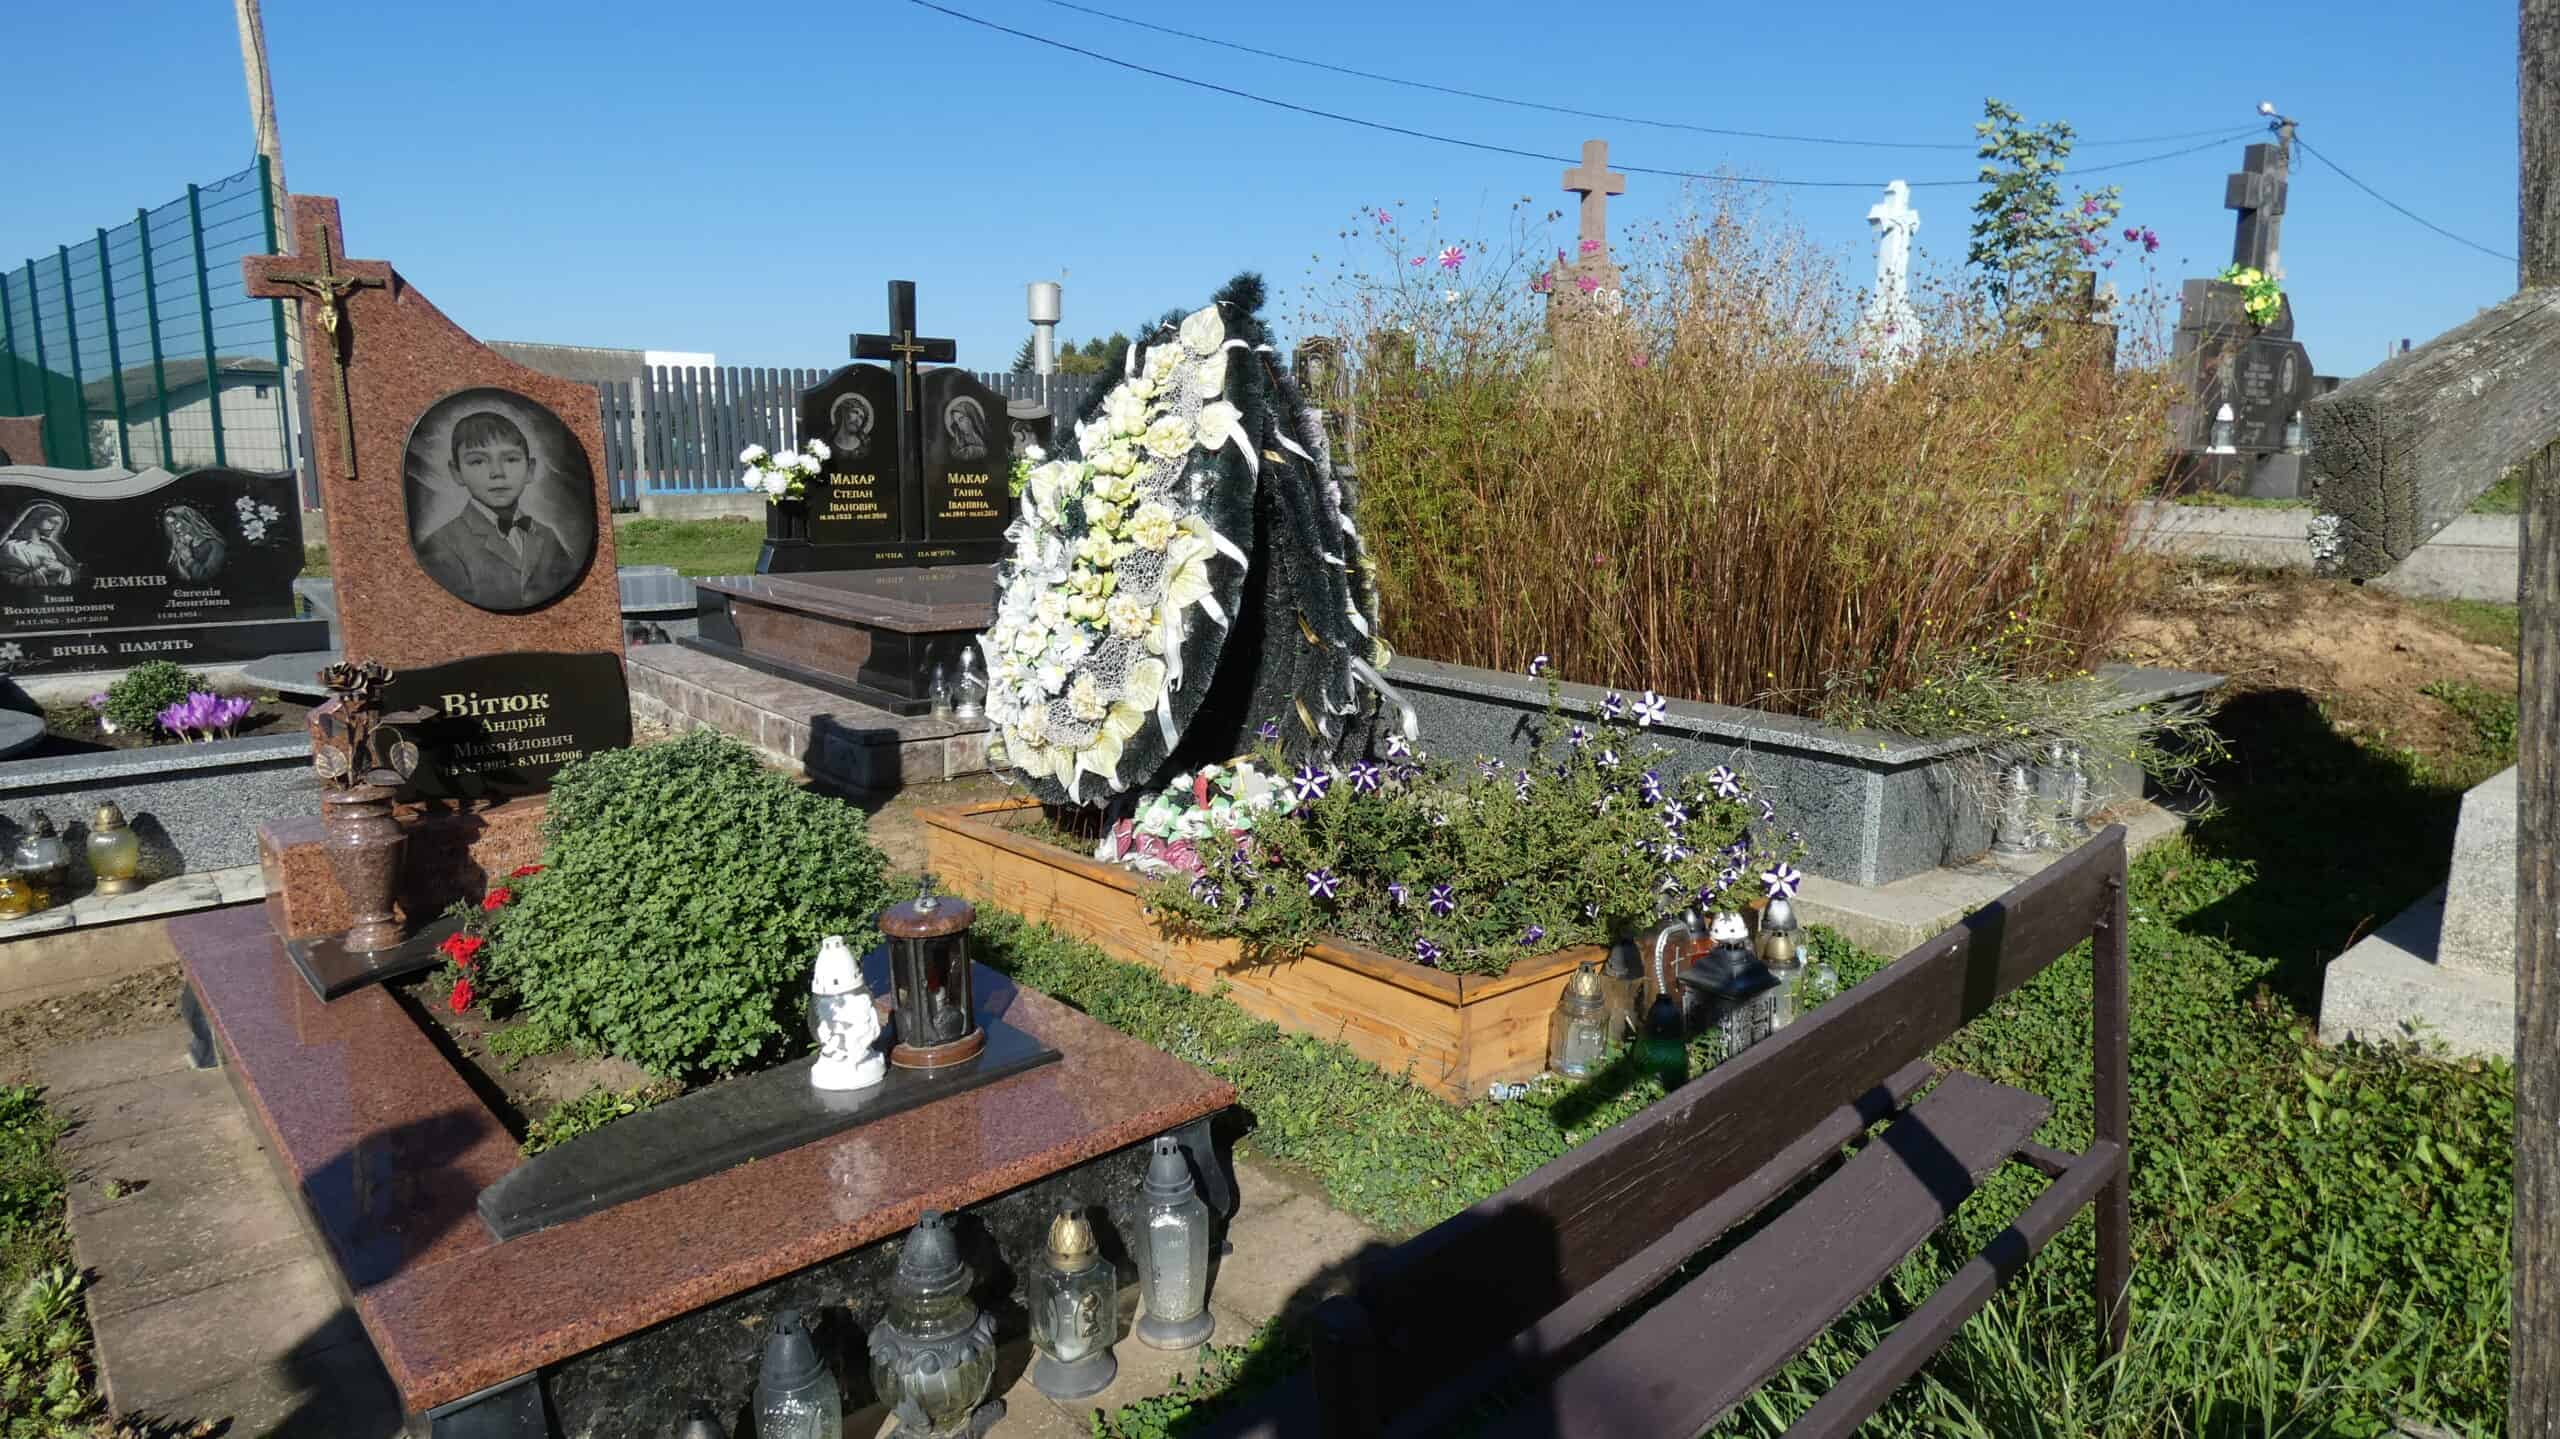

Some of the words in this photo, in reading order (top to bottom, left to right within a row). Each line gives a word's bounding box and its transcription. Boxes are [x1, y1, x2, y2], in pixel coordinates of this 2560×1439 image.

[93, 575, 168, 590] ДЕМКІВ
[53, 644, 109, 657] ВІЧНА
[440, 691, 550, 718] Вітюк
[481, 713, 546, 733] Андрій
